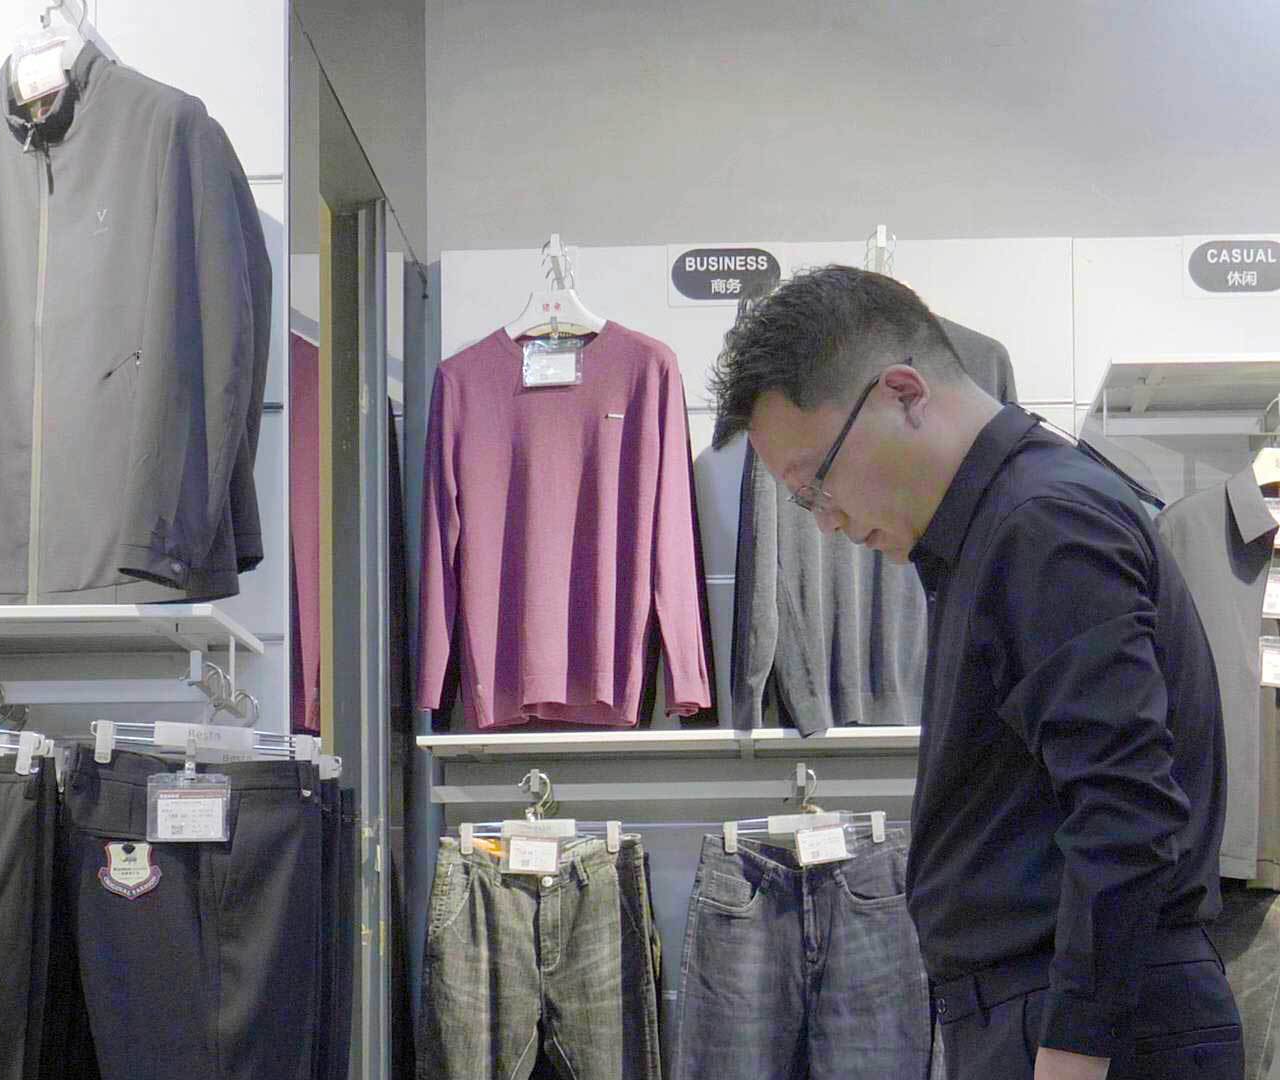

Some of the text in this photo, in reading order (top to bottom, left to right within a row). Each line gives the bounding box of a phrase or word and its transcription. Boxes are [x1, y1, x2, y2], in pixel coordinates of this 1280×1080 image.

[685, 255, 768, 271] BUSINESS
[1206, 248, 1277, 264] CASUAL
[1227, 269, 1258, 286] 休闲
[711, 278, 742, 294] 商务
